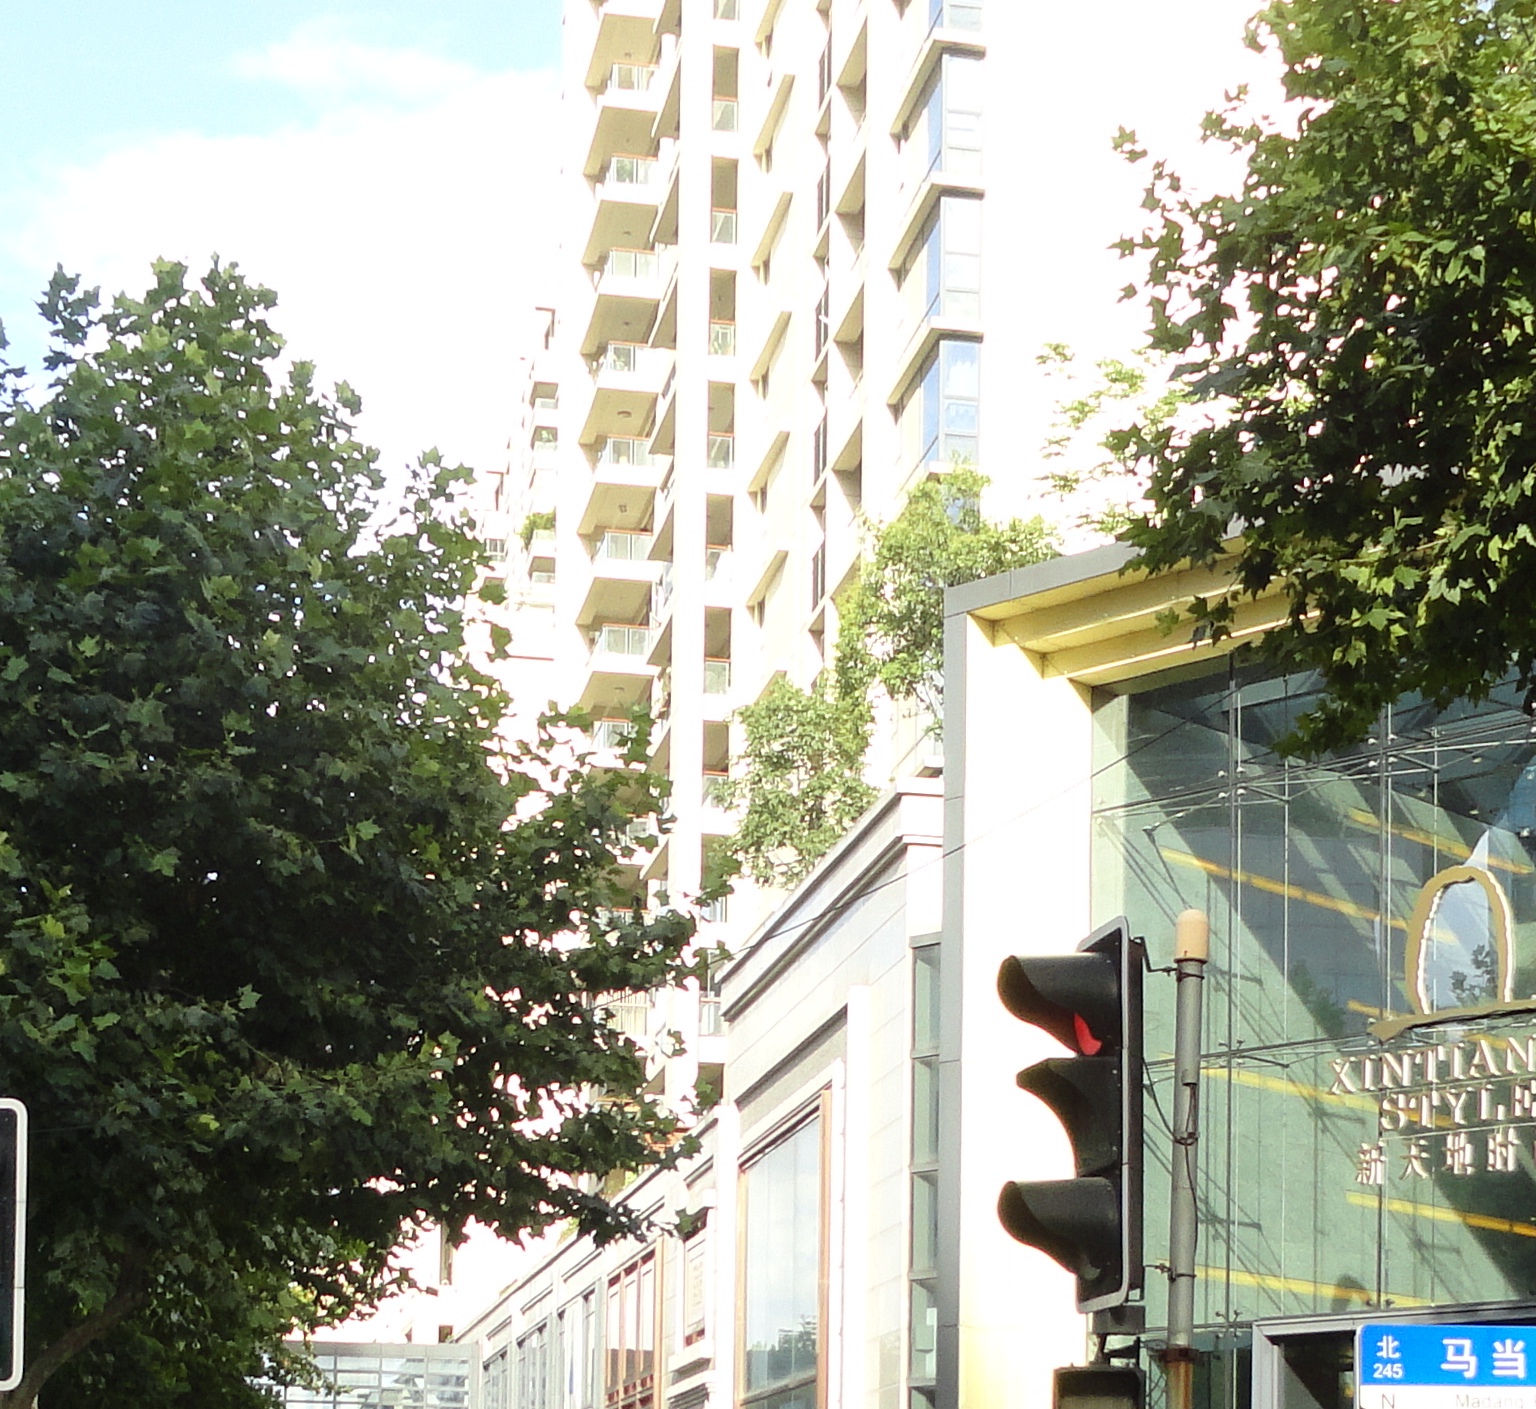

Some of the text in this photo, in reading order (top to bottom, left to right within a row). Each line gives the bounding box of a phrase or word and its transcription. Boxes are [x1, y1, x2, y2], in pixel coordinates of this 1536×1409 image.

[1376, 1335, 1401, 1359] 北
[1373, 1363, 1403, 1380] 245
[1381, 1393, 1396, 1409] N
